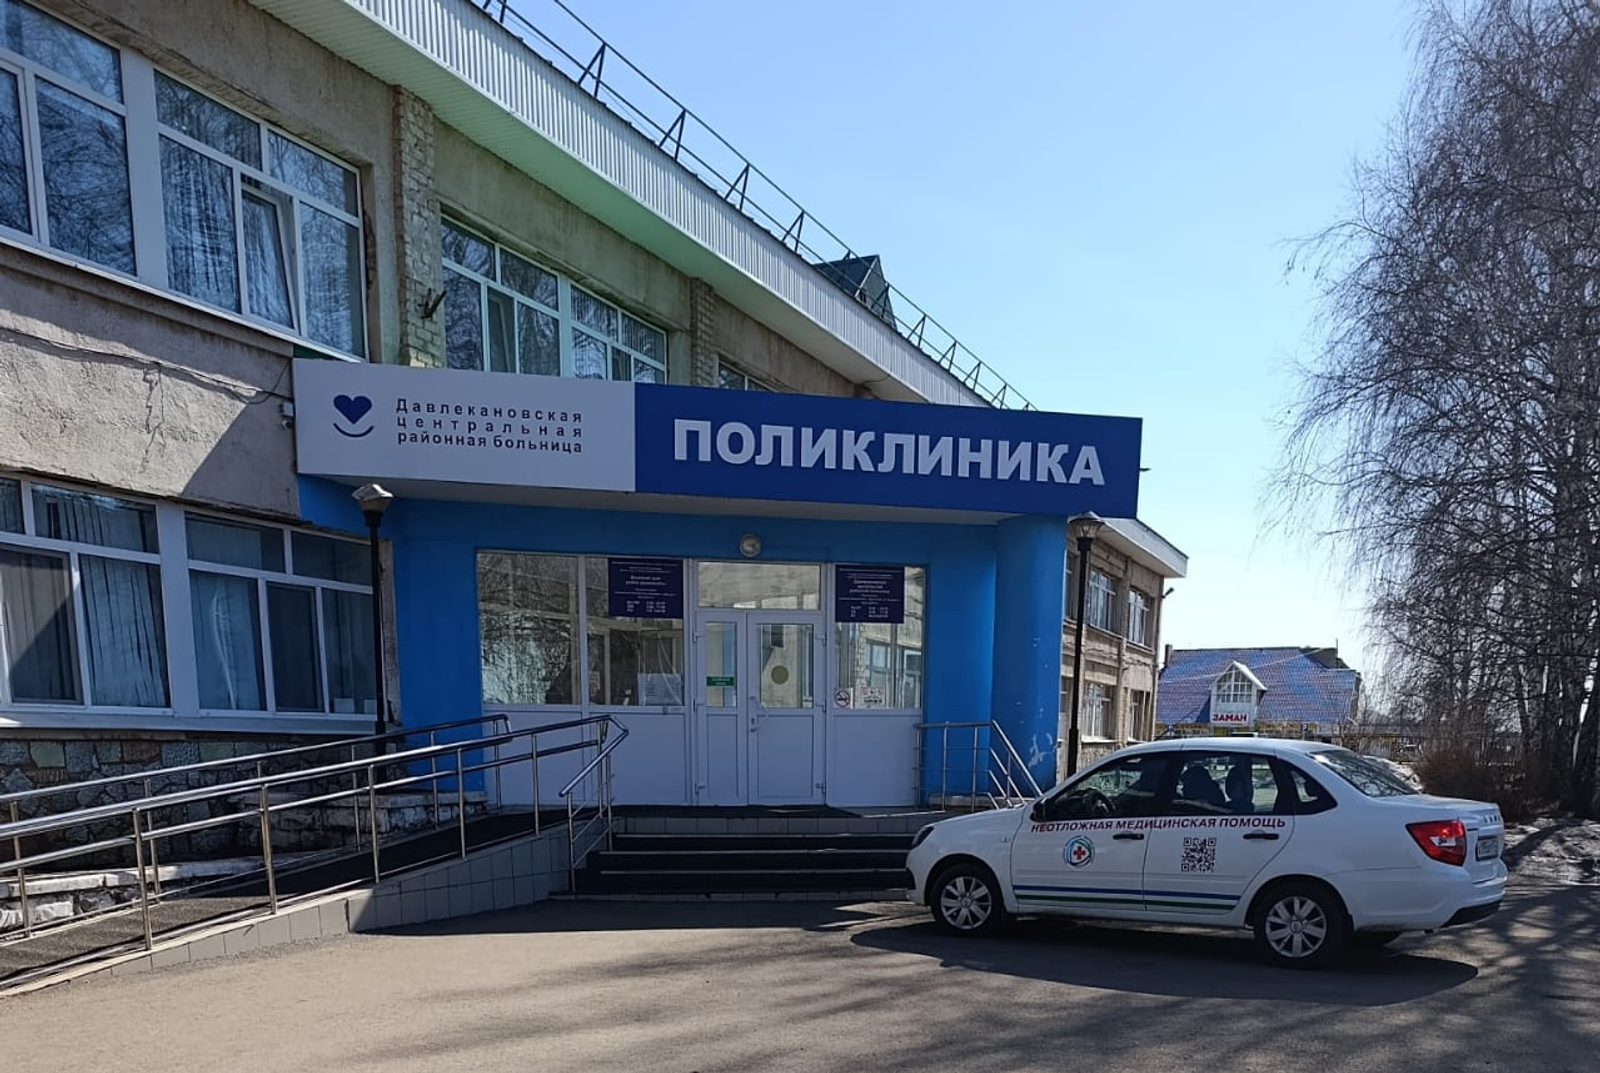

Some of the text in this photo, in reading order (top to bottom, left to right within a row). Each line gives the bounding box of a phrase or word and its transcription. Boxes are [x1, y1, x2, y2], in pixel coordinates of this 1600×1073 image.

[396, 398, 582, 423] Давлекановская
[396, 416, 582, 437] центральная
[398, 431, 582, 455] районная больница
[673, 418, 1106, 486] ПОЛИКЛИНИКА
[1212, 713, 1247, 722] ЗАМАН
[1031, 817, 1286, 833] НЕОТЛОЖНАЯ МЕДИЦИНСКАЯ ПОМОЩЬ
